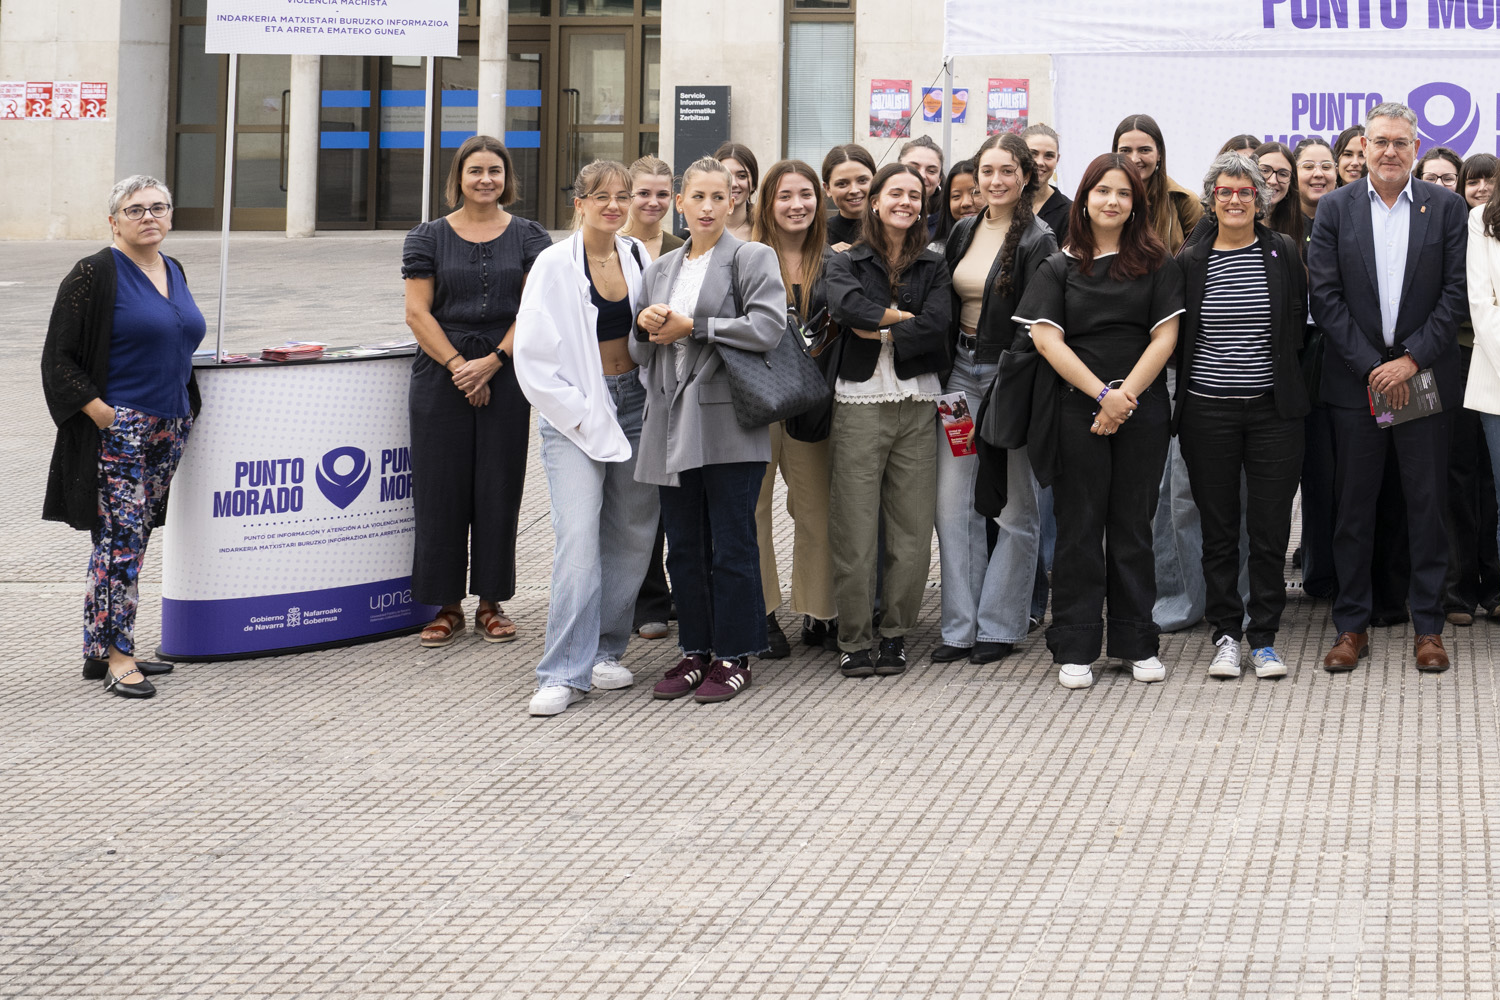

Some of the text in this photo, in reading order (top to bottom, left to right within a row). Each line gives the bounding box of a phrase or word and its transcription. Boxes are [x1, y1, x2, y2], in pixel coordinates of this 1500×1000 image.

[217, 15, 449, 27] INDARKERIA MATXISTARI BURUZKO INFORMAZIOA
[265, 25, 406, 36] ETA ARRETA EMATEKO GUNEA
[871, 93, 910, 110] SOZIALISTA
[988, 92, 1027, 109] SOZIALISTA
[380, 446, 412, 475] PUN
[234, 457, 305, 488] PUNTO
[380, 474, 414, 502] MOR
[213, 486, 304, 518] MORADO
[259, 542, 297, 550] MATXISTARI
[297, 539, 327, 547] BURUZKO
[328, 534, 368, 544] INFORMAZIOA
[380, 529, 401, 537] ARRETA
[401, 526, 416, 534] EMAT
[277, 529, 320, 539] INFORMACIÓN
[327, 525, 357, 533] ATENCIÓN
[371, 520, 399, 528] VIOLENCIA
[369, 589, 412, 612] upna
[250, 614, 285, 624] Gobierno
[303, 606, 343, 618] Nafarroako
[303, 615, 338, 625] Gobernua
[243, 622, 284, 632] de Navarra
